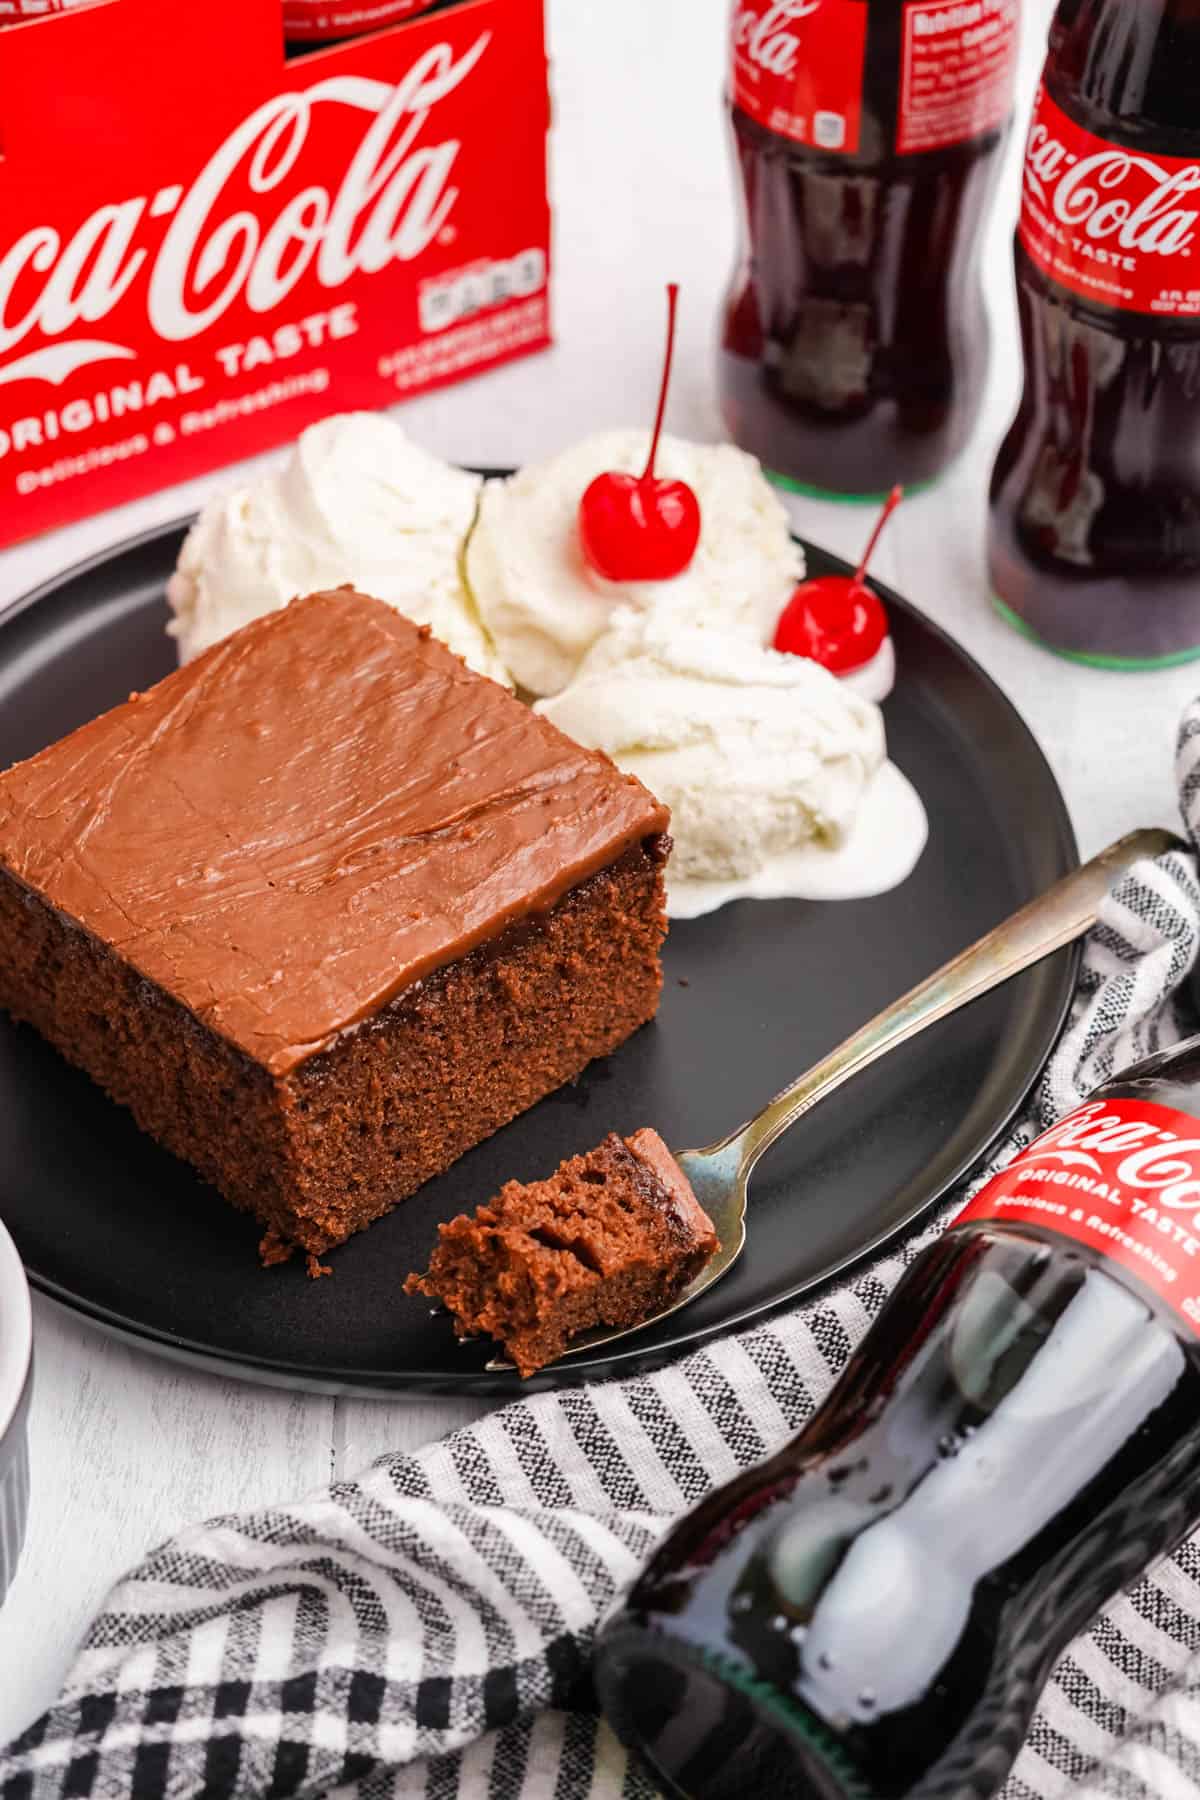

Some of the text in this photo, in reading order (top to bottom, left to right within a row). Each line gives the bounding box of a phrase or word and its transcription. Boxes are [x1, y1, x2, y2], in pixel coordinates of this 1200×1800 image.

[0, 30, 492, 360] ca-Cola
[1026, 122, 1200, 257] ca-Cola
[1072, 237, 1137, 273] TASTE
[215, 303, 360, 378] TASTE
[16, 432, 150, 496] Delicious
[179, 366, 331, 437] Refreshing
[994, 1193, 1177, 1284] Delicious & Refreshing
[1016, 1167, 1200, 1257] ORIGINAL TASTE
